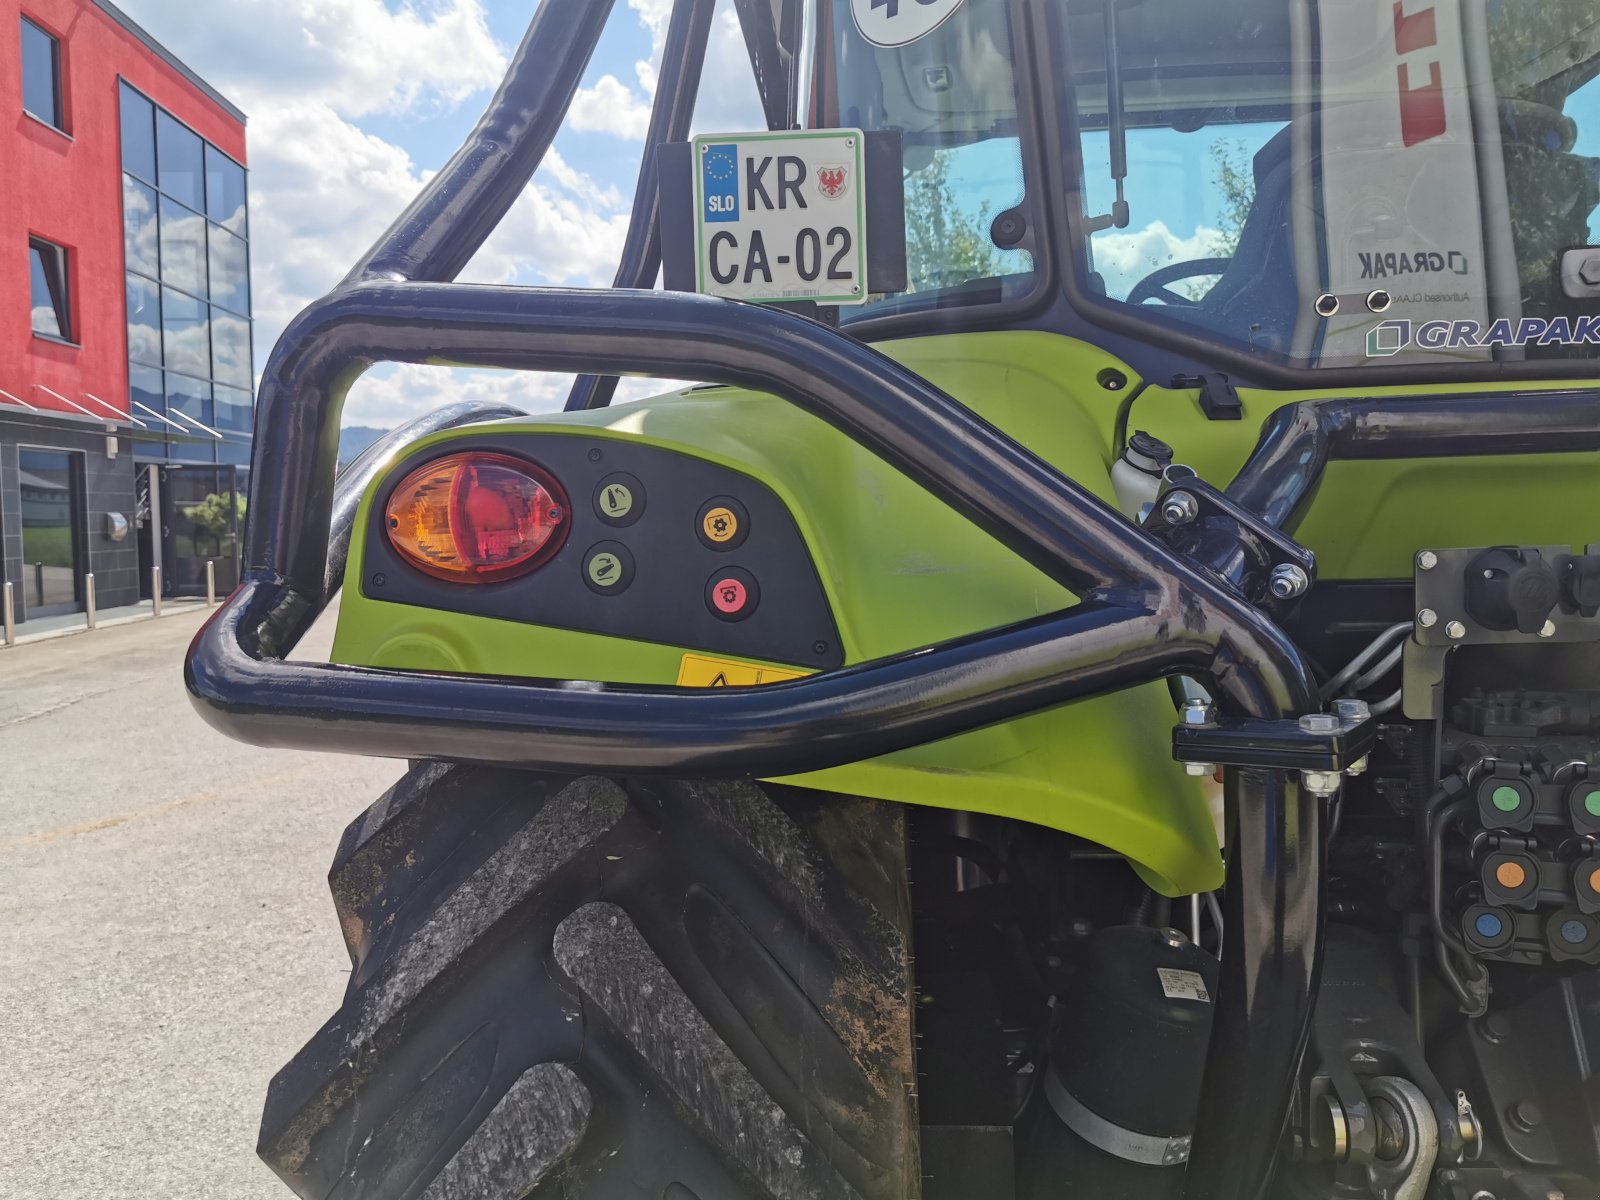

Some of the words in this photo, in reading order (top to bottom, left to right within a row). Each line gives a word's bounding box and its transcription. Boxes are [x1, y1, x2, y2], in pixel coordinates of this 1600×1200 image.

[708, 195, 735, 212] SLO
[746, 156, 808, 210] KR
[709, 226, 853, 284] CA-02
[1416, 316, 1600, 349] GRAPAK
